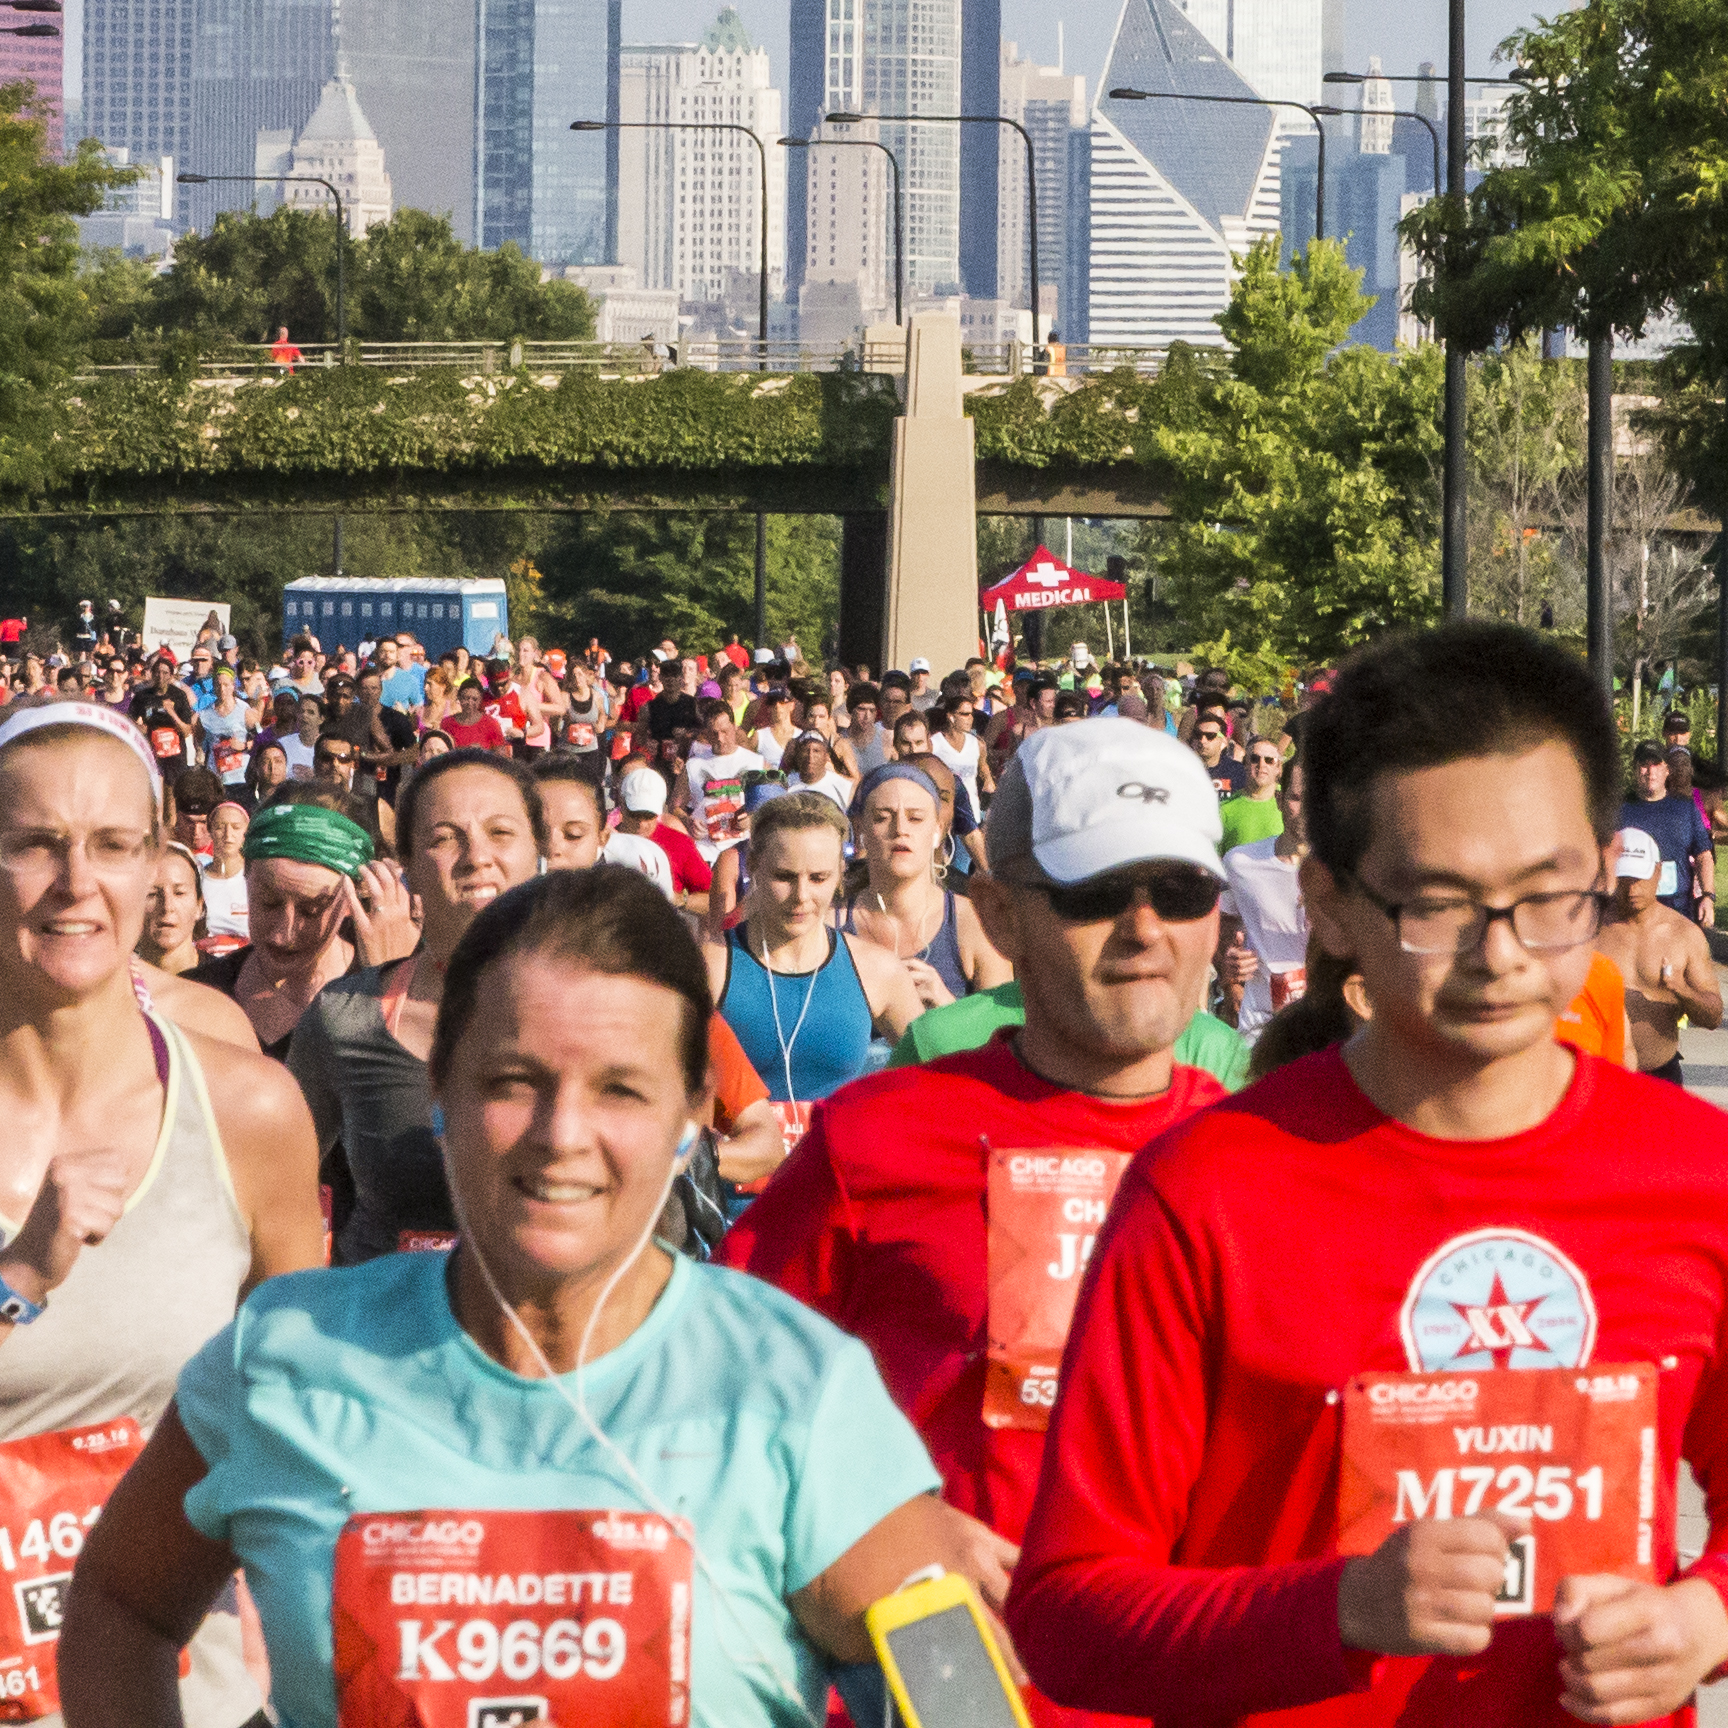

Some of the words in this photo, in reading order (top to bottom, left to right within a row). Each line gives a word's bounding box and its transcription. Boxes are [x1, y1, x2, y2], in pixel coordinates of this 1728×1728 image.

[1015, 588, 1092, 608] MEDICAL
[1010, 1156, 1106, 1177] CHICAGO
[1437, 1246, 1554, 1286] CHICAGO
[1369, 1379, 1480, 1404] CHICAGO
[1453, 1425, 1554, 1454] YUXIN
[1392, 1464, 1604, 1522] M7251
[362, 1519, 484, 1546] CHICAGO
[390, 1571, 633, 1607] BERNADETTE
[395, 1616, 628, 1682] K9669
